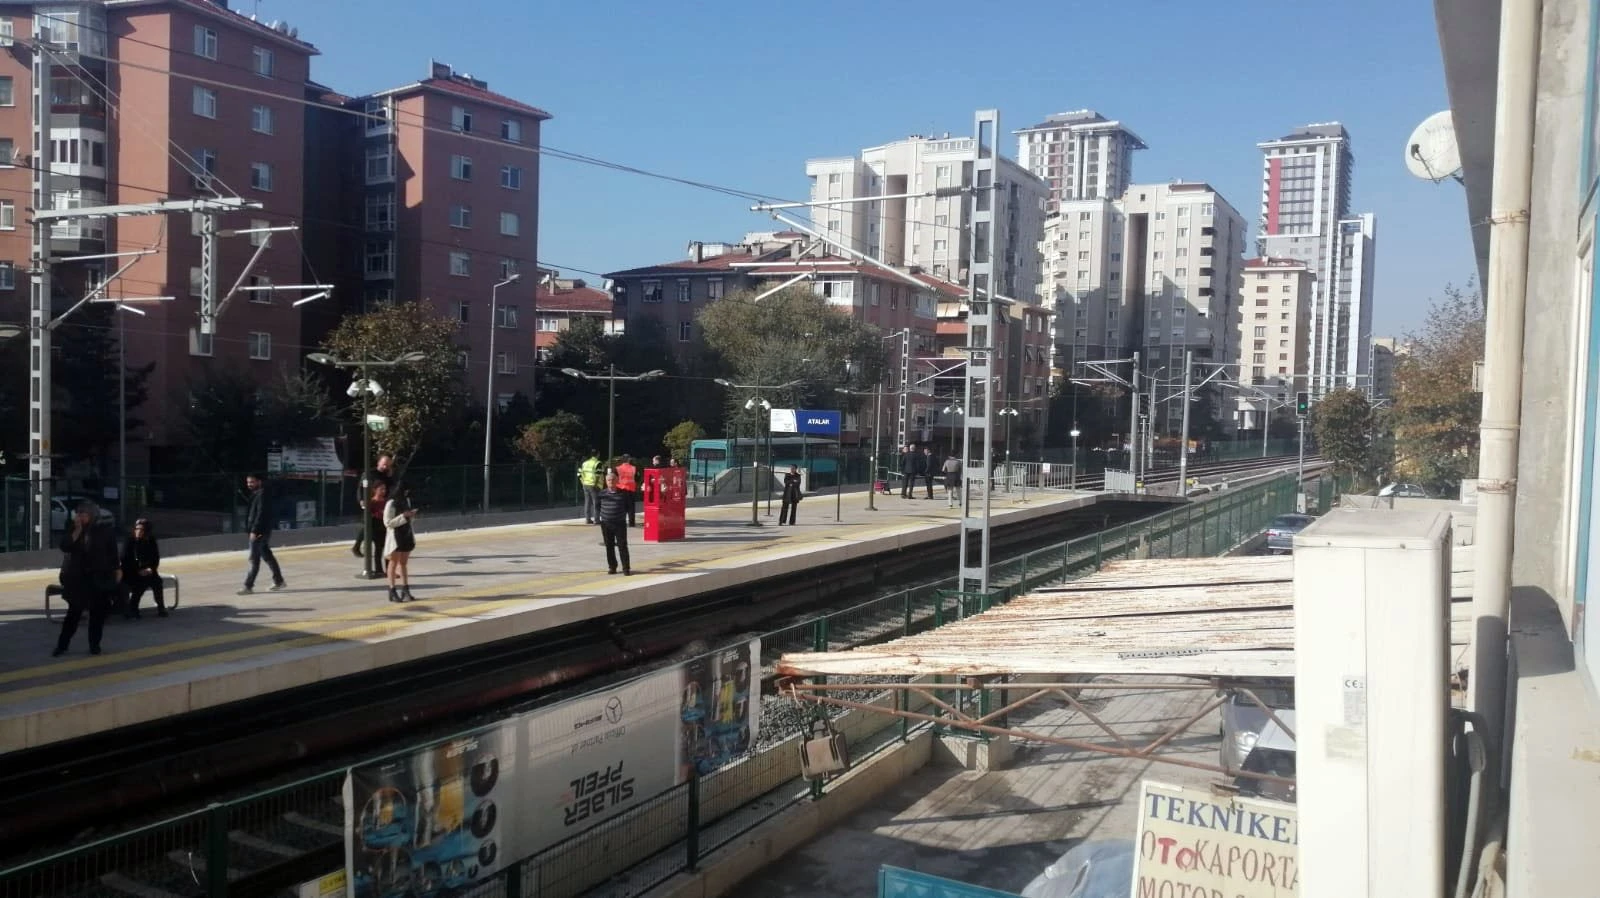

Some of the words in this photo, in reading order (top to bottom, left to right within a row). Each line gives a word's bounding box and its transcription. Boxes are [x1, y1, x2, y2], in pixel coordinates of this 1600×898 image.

[564, 777, 635, 826] SILBER
[570, 760, 624, 799] PFEIL
[1146, 792, 1298, 846] TEKNİKE
[1139, 876, 1223, 898] MOT
